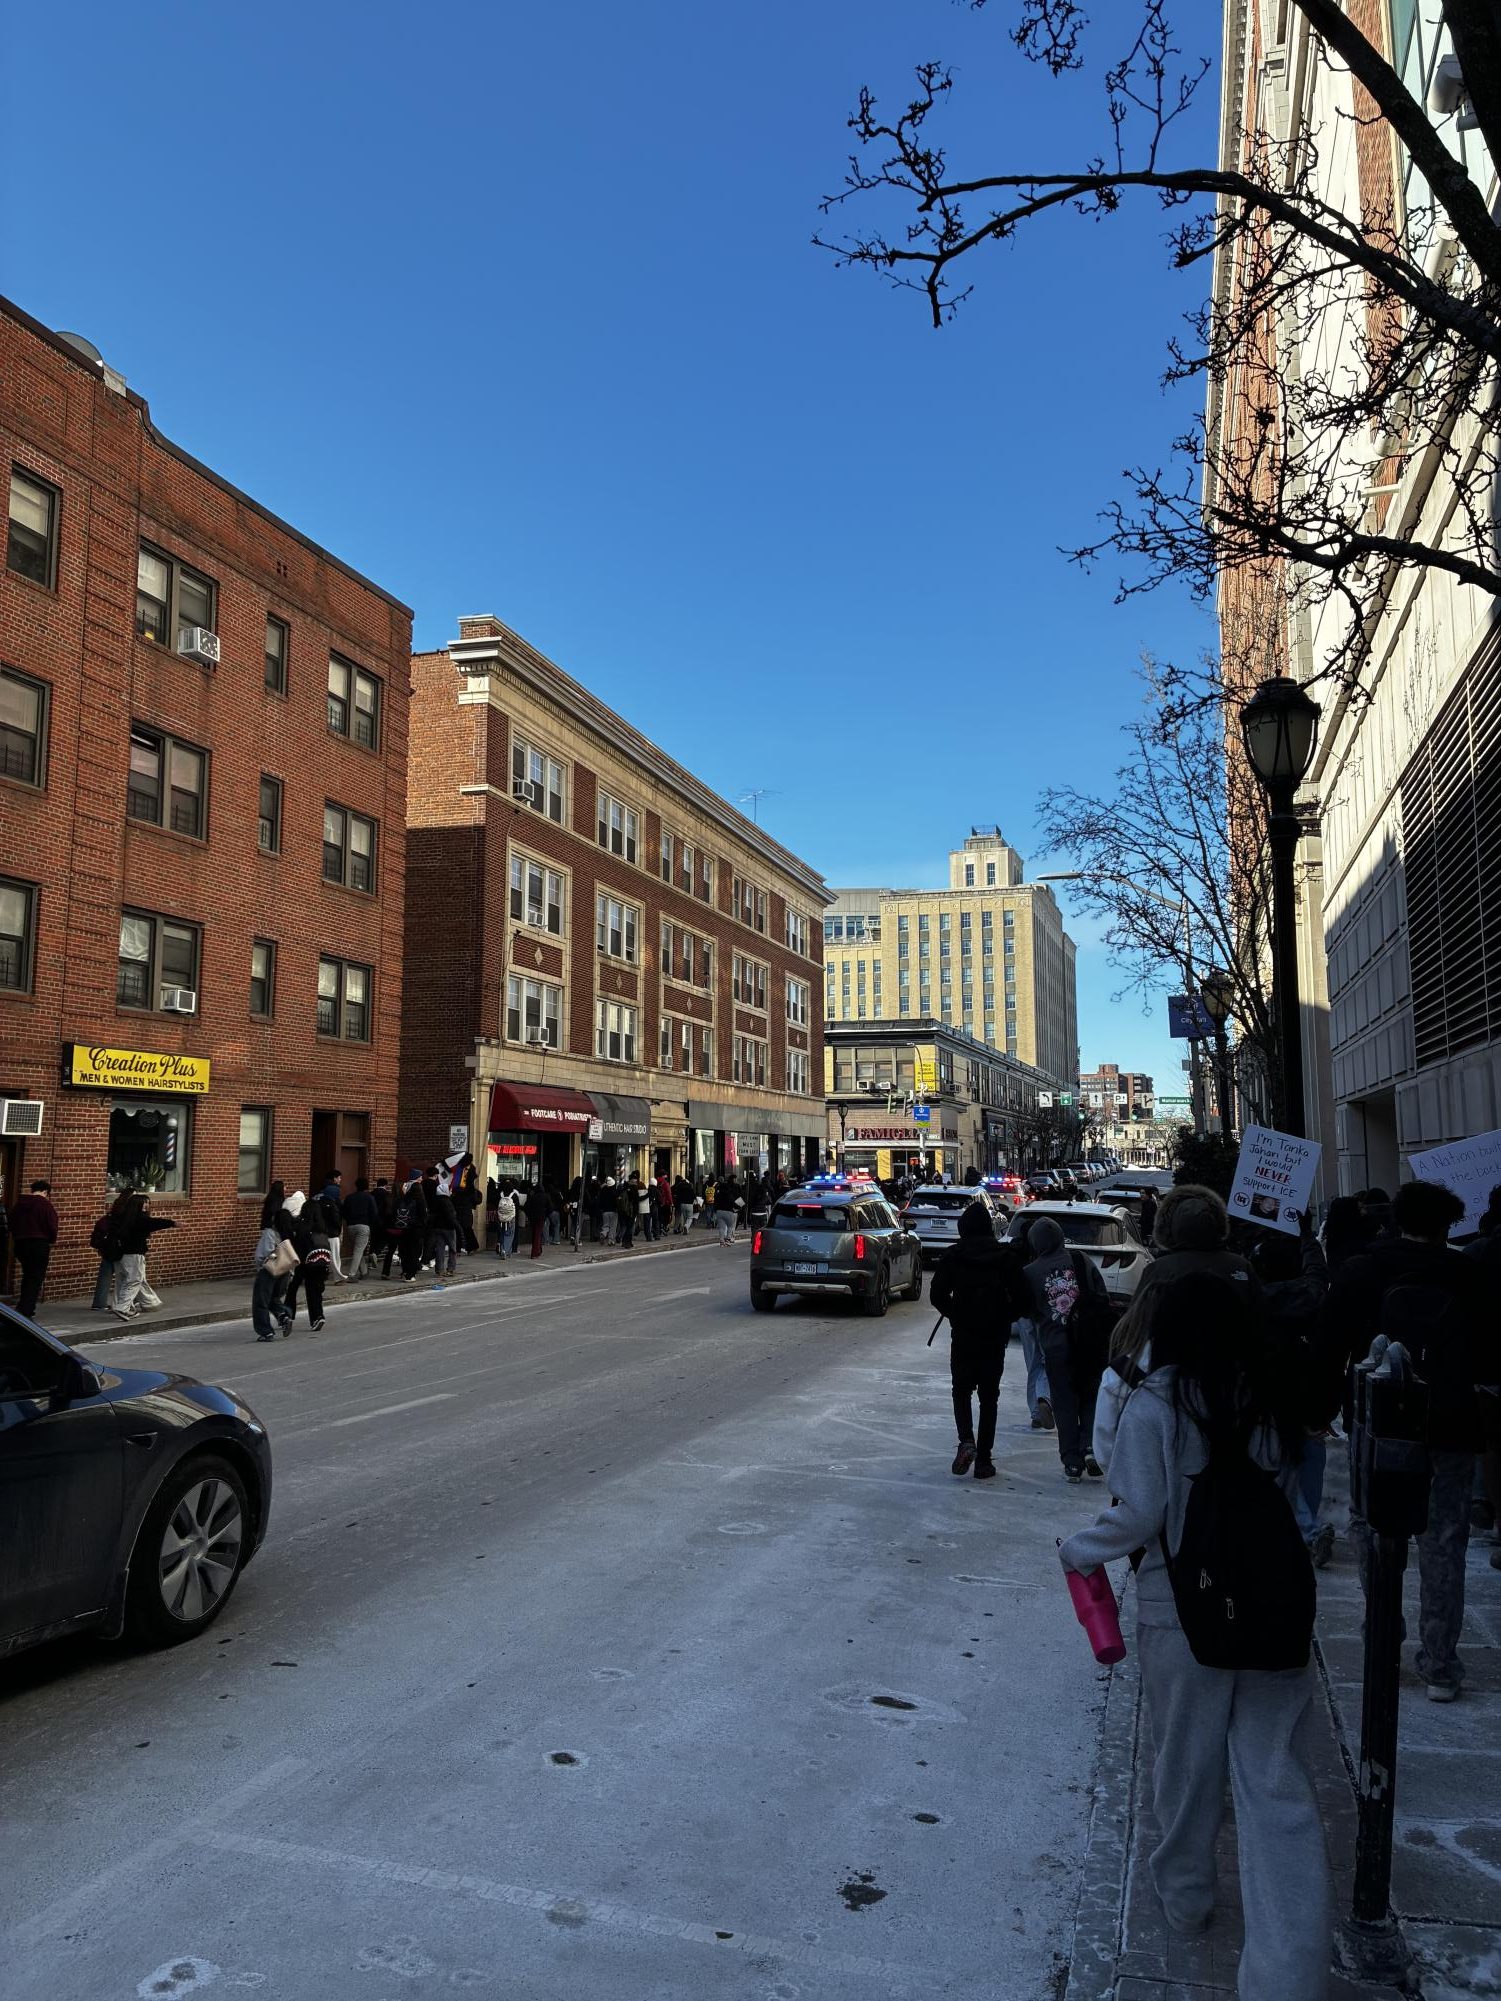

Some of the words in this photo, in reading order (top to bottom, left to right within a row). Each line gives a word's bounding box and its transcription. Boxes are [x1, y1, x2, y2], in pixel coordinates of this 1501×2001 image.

[89, 1047, 157, 1074] Creation
[159, 1055, 198, 1077] Plus
[80, 1073, 101, 1084] MEN
[103, 1076, 109, 1084] &
[111, 1076, 145, 1087] WOMEN
[148, 1079, 205, 1091] HAIRSTYLISTS
[531, 1109, 557, 1119] FOOTCARE
[604, 1122, 624, 1133] UTHENTIC
[1256, 1133, 1273, 1146] I'm
[1258, 1156, 1263, 1164] I
[1265, 1158, 1293, 1172] would
[1284, 1153, 1302, 1166] but
[1419, 1160, 1430, 1174] A
[1431, 1150, 1476, 1169] Nation
[1254, 1166, 1292, 1184] NEVER
[1450, 1172, 1473, 1184] the
[1243, 1176, 1276, 1192] support
[1280, 1186, 1298, 1198] ICE
